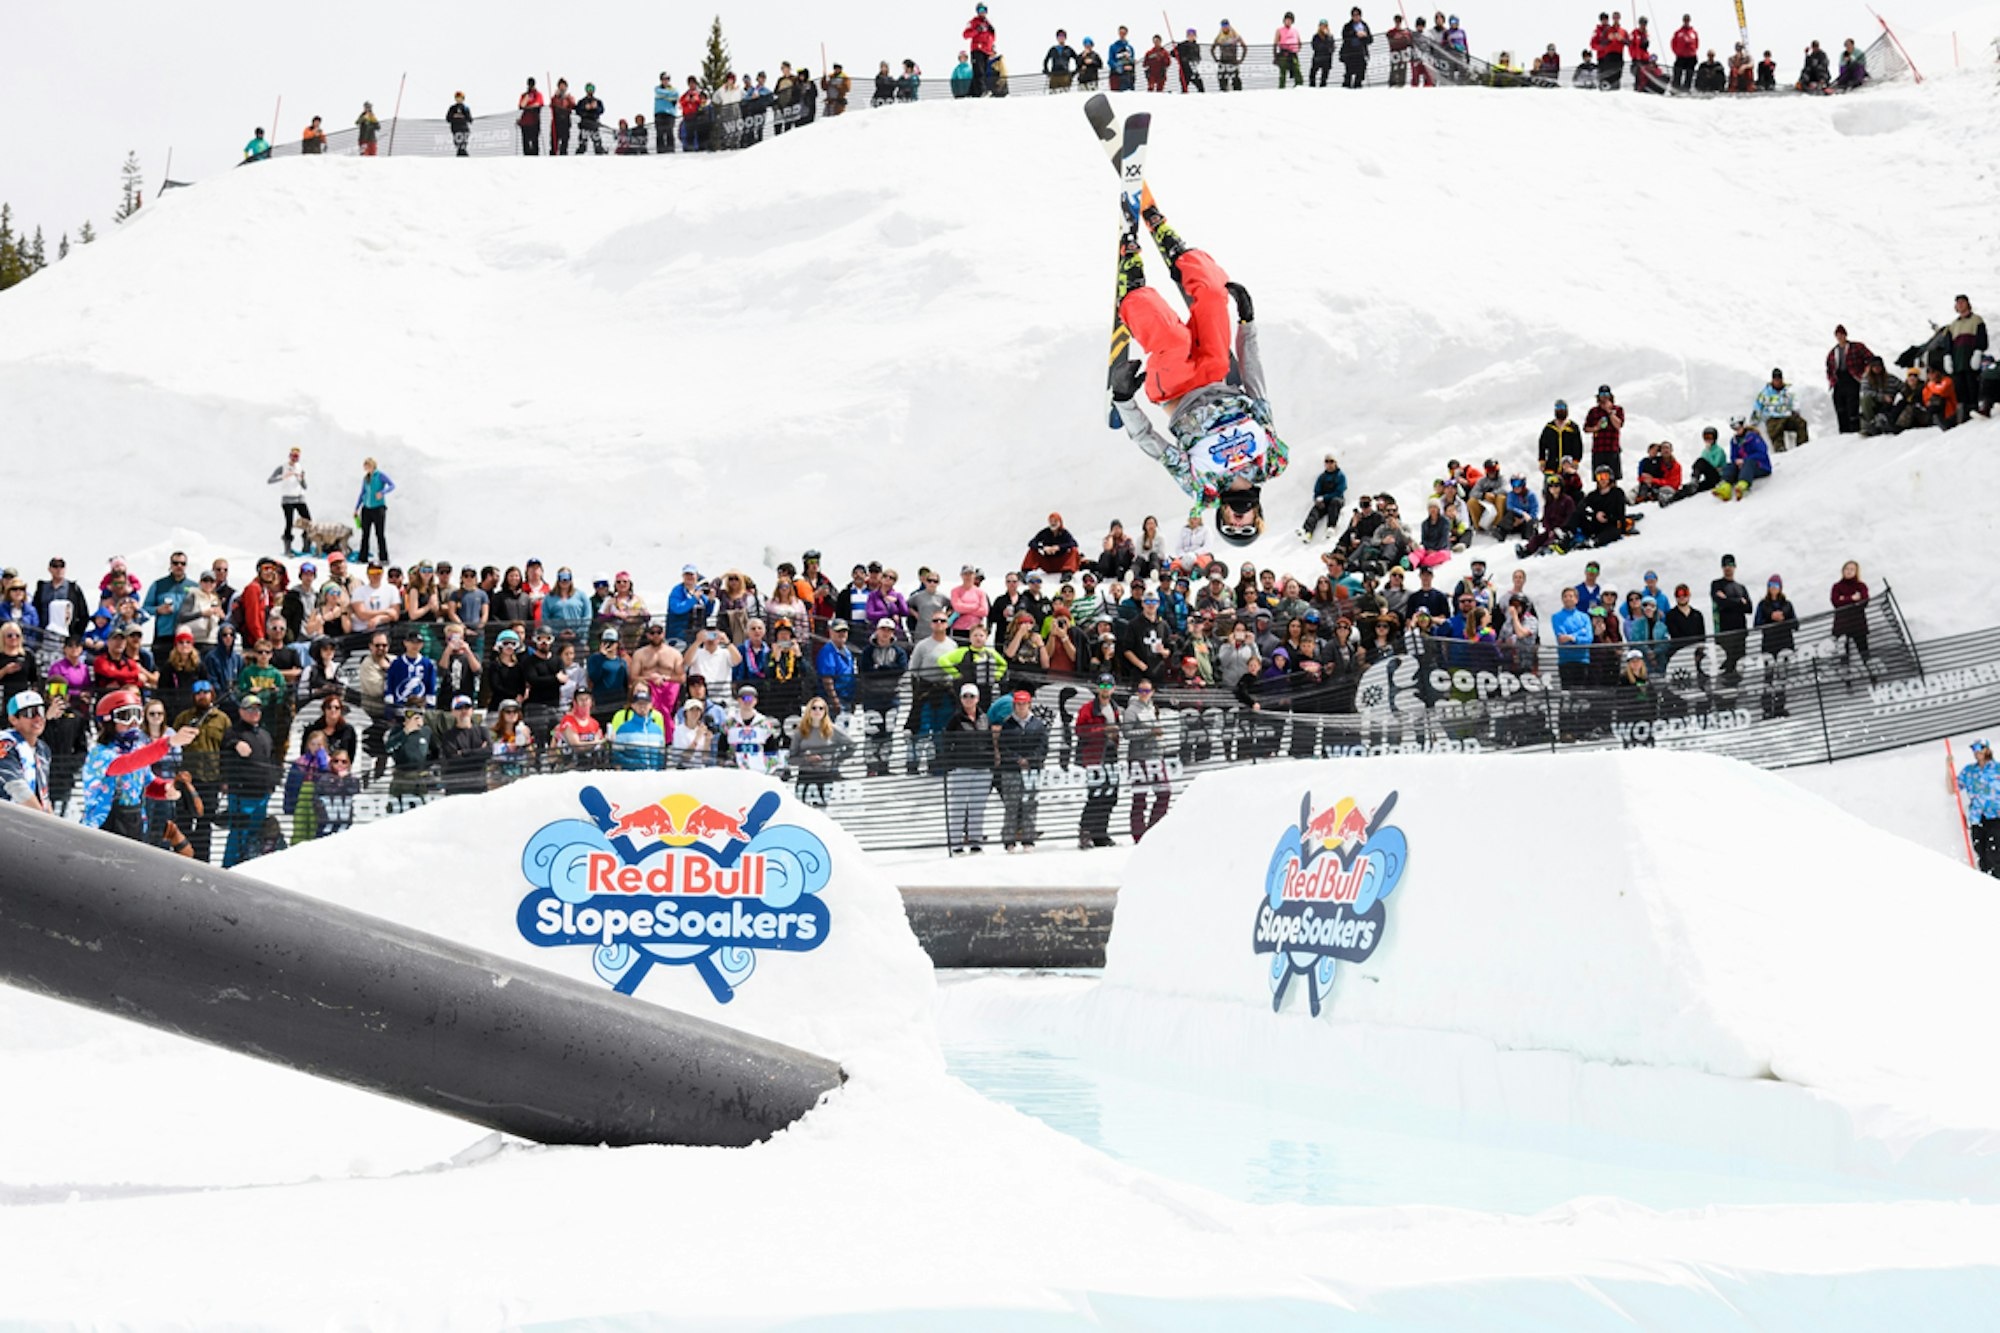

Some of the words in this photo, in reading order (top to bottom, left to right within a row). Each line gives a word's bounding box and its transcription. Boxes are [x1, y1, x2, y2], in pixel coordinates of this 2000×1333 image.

[1610, 708, 1751, 742] WOODWARD
[588, 853, 674, 893] Red
[684, 855, 764, 895] Bull
[1282, 857, 1325, 898] Red
[1320, 858, 1368, 901] Bull
[536, 898, 817, 947] SlopeSoakers
[1257, 904, 1376, 953] SlopeSoakers
